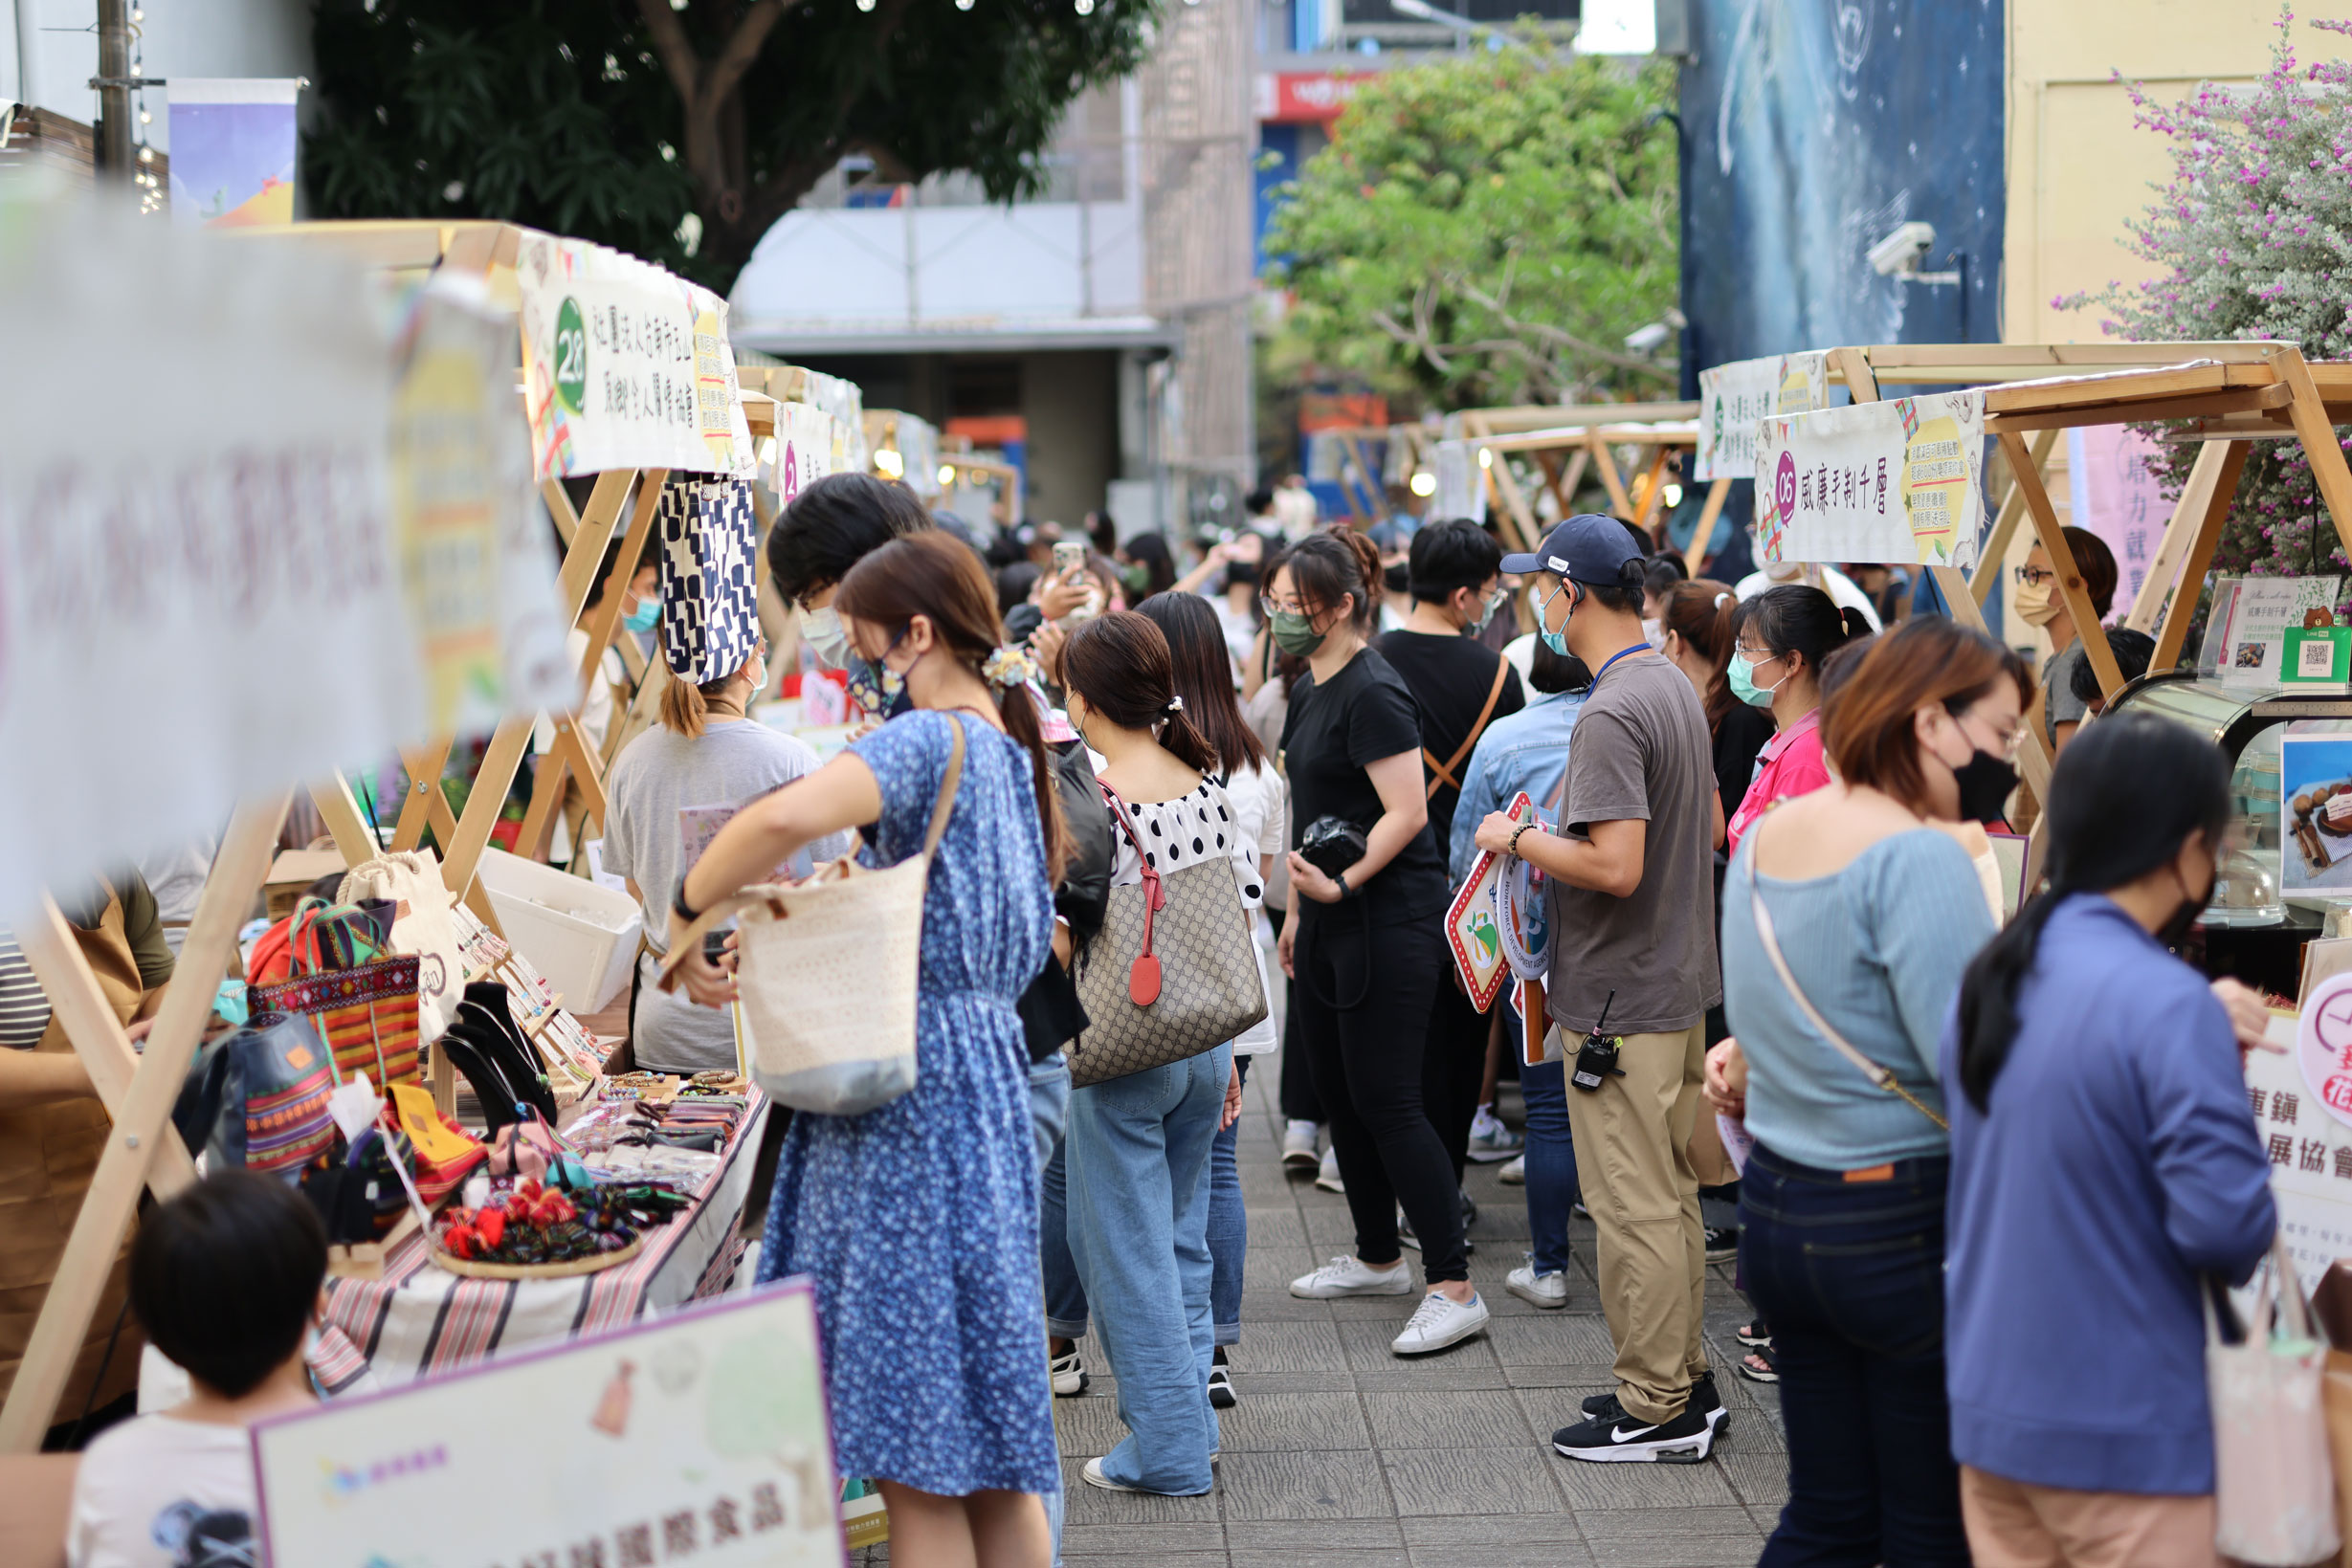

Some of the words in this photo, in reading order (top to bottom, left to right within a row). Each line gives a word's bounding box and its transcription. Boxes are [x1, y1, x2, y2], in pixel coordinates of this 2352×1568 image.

[557, 328, 586, 383] 28
[1779, 472, 1794, 504] 06
[1503, 880, 1515, 934] WORKFORCE
[1508, 933, 1534, 969] DEVELOPMENT
